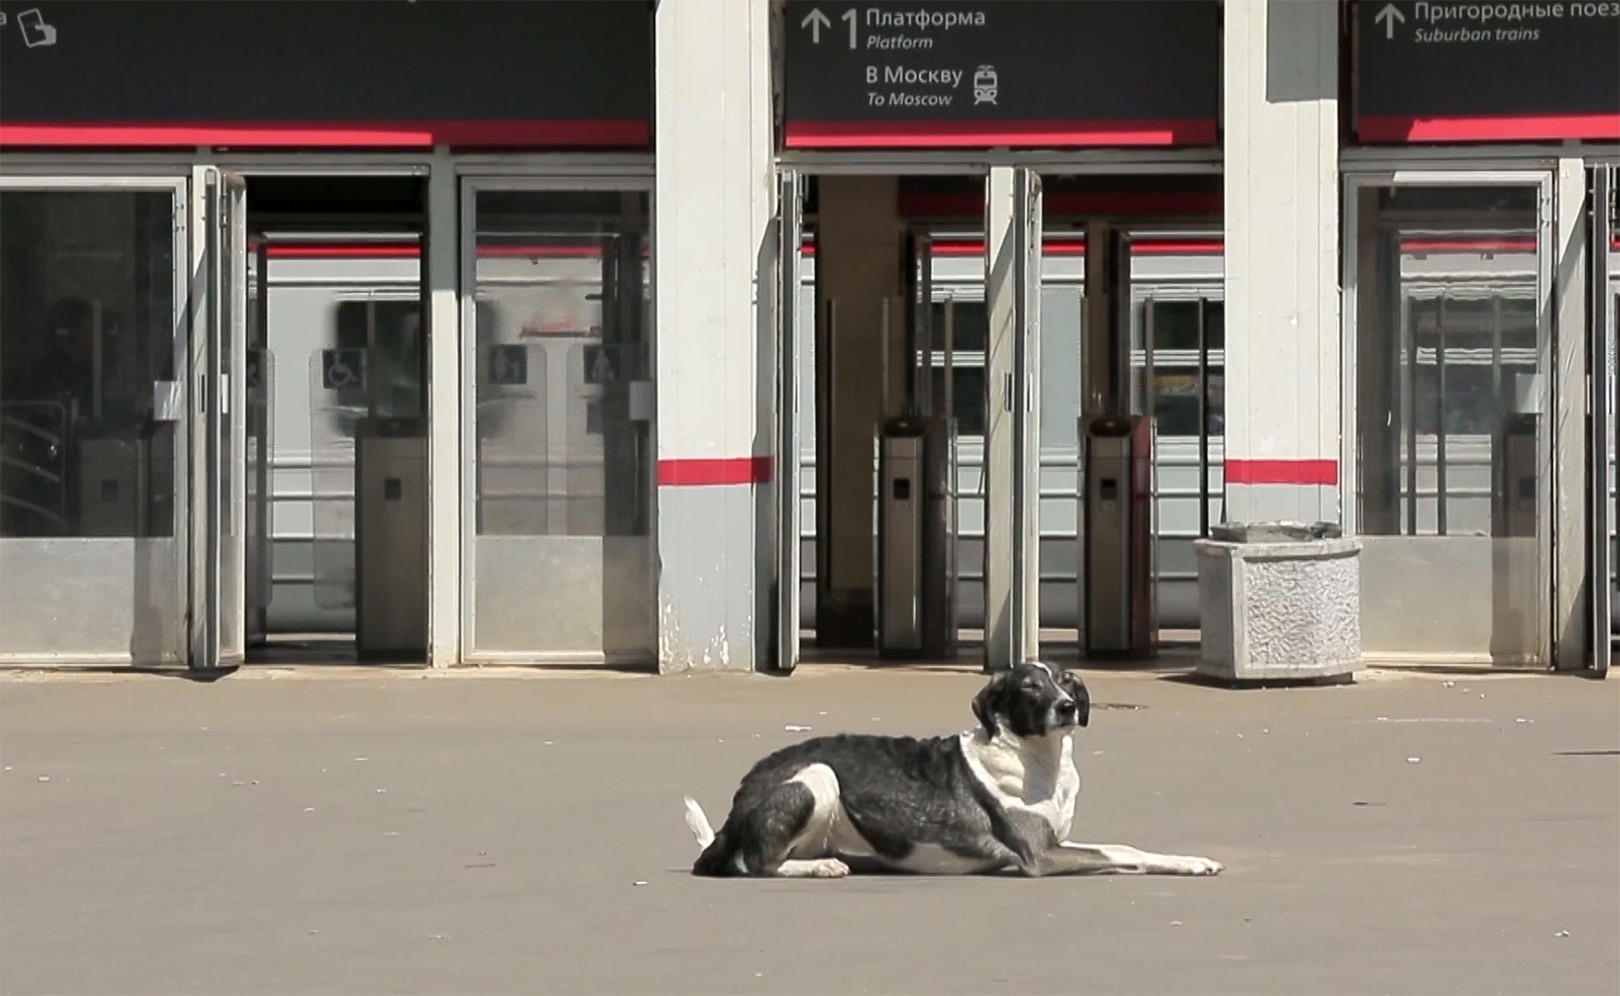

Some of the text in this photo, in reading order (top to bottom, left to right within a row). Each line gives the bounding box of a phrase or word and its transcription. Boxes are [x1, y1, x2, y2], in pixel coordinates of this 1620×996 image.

[1415, 2, 1620, 24] Пригородные поез
[842, 8, 986, 50] 1 Платформа
[1415, 28, 1540, 43] Suburban trains
[866, 34, 933, 50] Platform
[866, 66, 963, 88] В Москву
[868, 92, 953, 106] To Moscow
